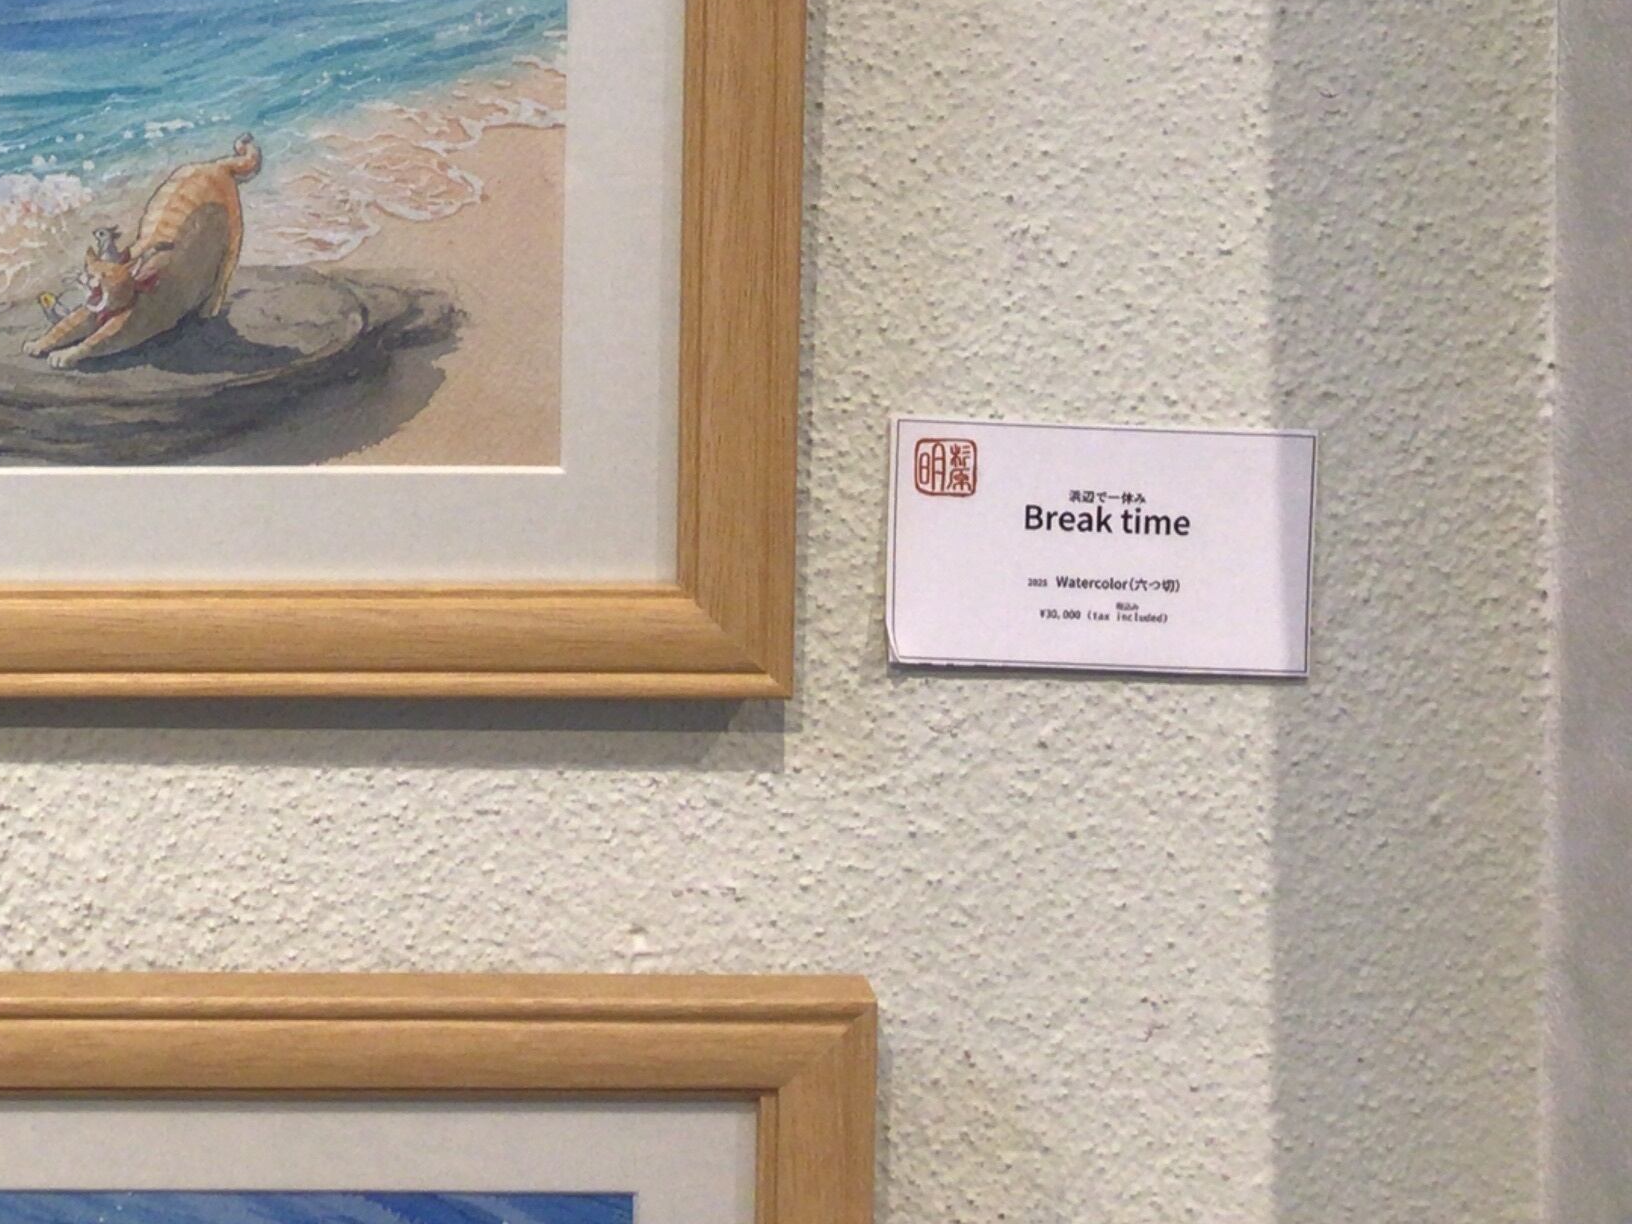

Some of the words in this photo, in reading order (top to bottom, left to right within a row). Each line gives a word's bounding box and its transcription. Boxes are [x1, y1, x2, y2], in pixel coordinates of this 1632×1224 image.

[1068, 489, 1147, 504] 浜辺で一休み
[1024, 504, 1113, 534] Break
[1120, 507, 1191, 536] time
